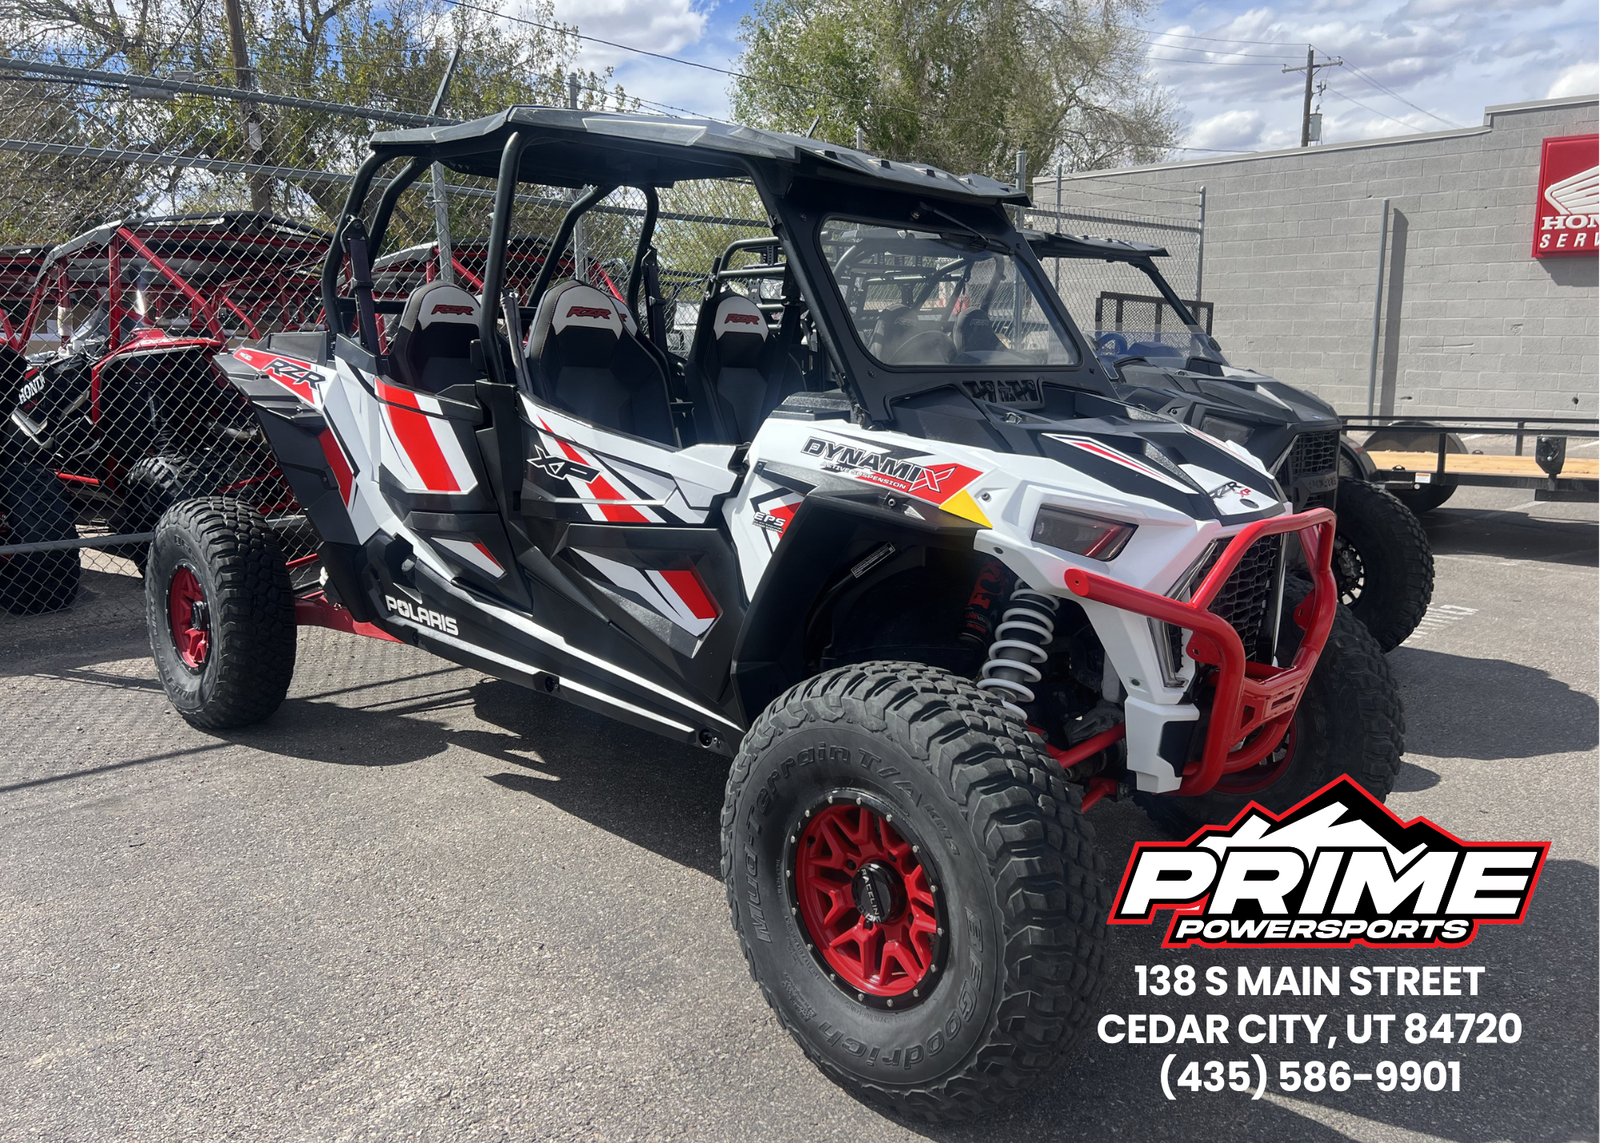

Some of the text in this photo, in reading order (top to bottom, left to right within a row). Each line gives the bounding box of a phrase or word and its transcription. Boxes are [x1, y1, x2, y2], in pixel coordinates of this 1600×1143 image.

[431, 304, 475, 316] RZR
[566, 306, 612, 320] RZR
[724, 313, 760, 326] RZR
[260, 357, 328, 393] RZR
[526, 444, 603, 484] XP
[801, 436, 958, 494] DYNAMIX
[850, 468, 908, 490] SUSPENSION
[752, 511, 787, 527] EPS
[384, 594, 459, 636] POLARIS
[744, 742, 850, 944] Mud-Terrain
[860, 868, 882, 923] RACELINE
[818, 906, 984, 1071] BFGoodrich
